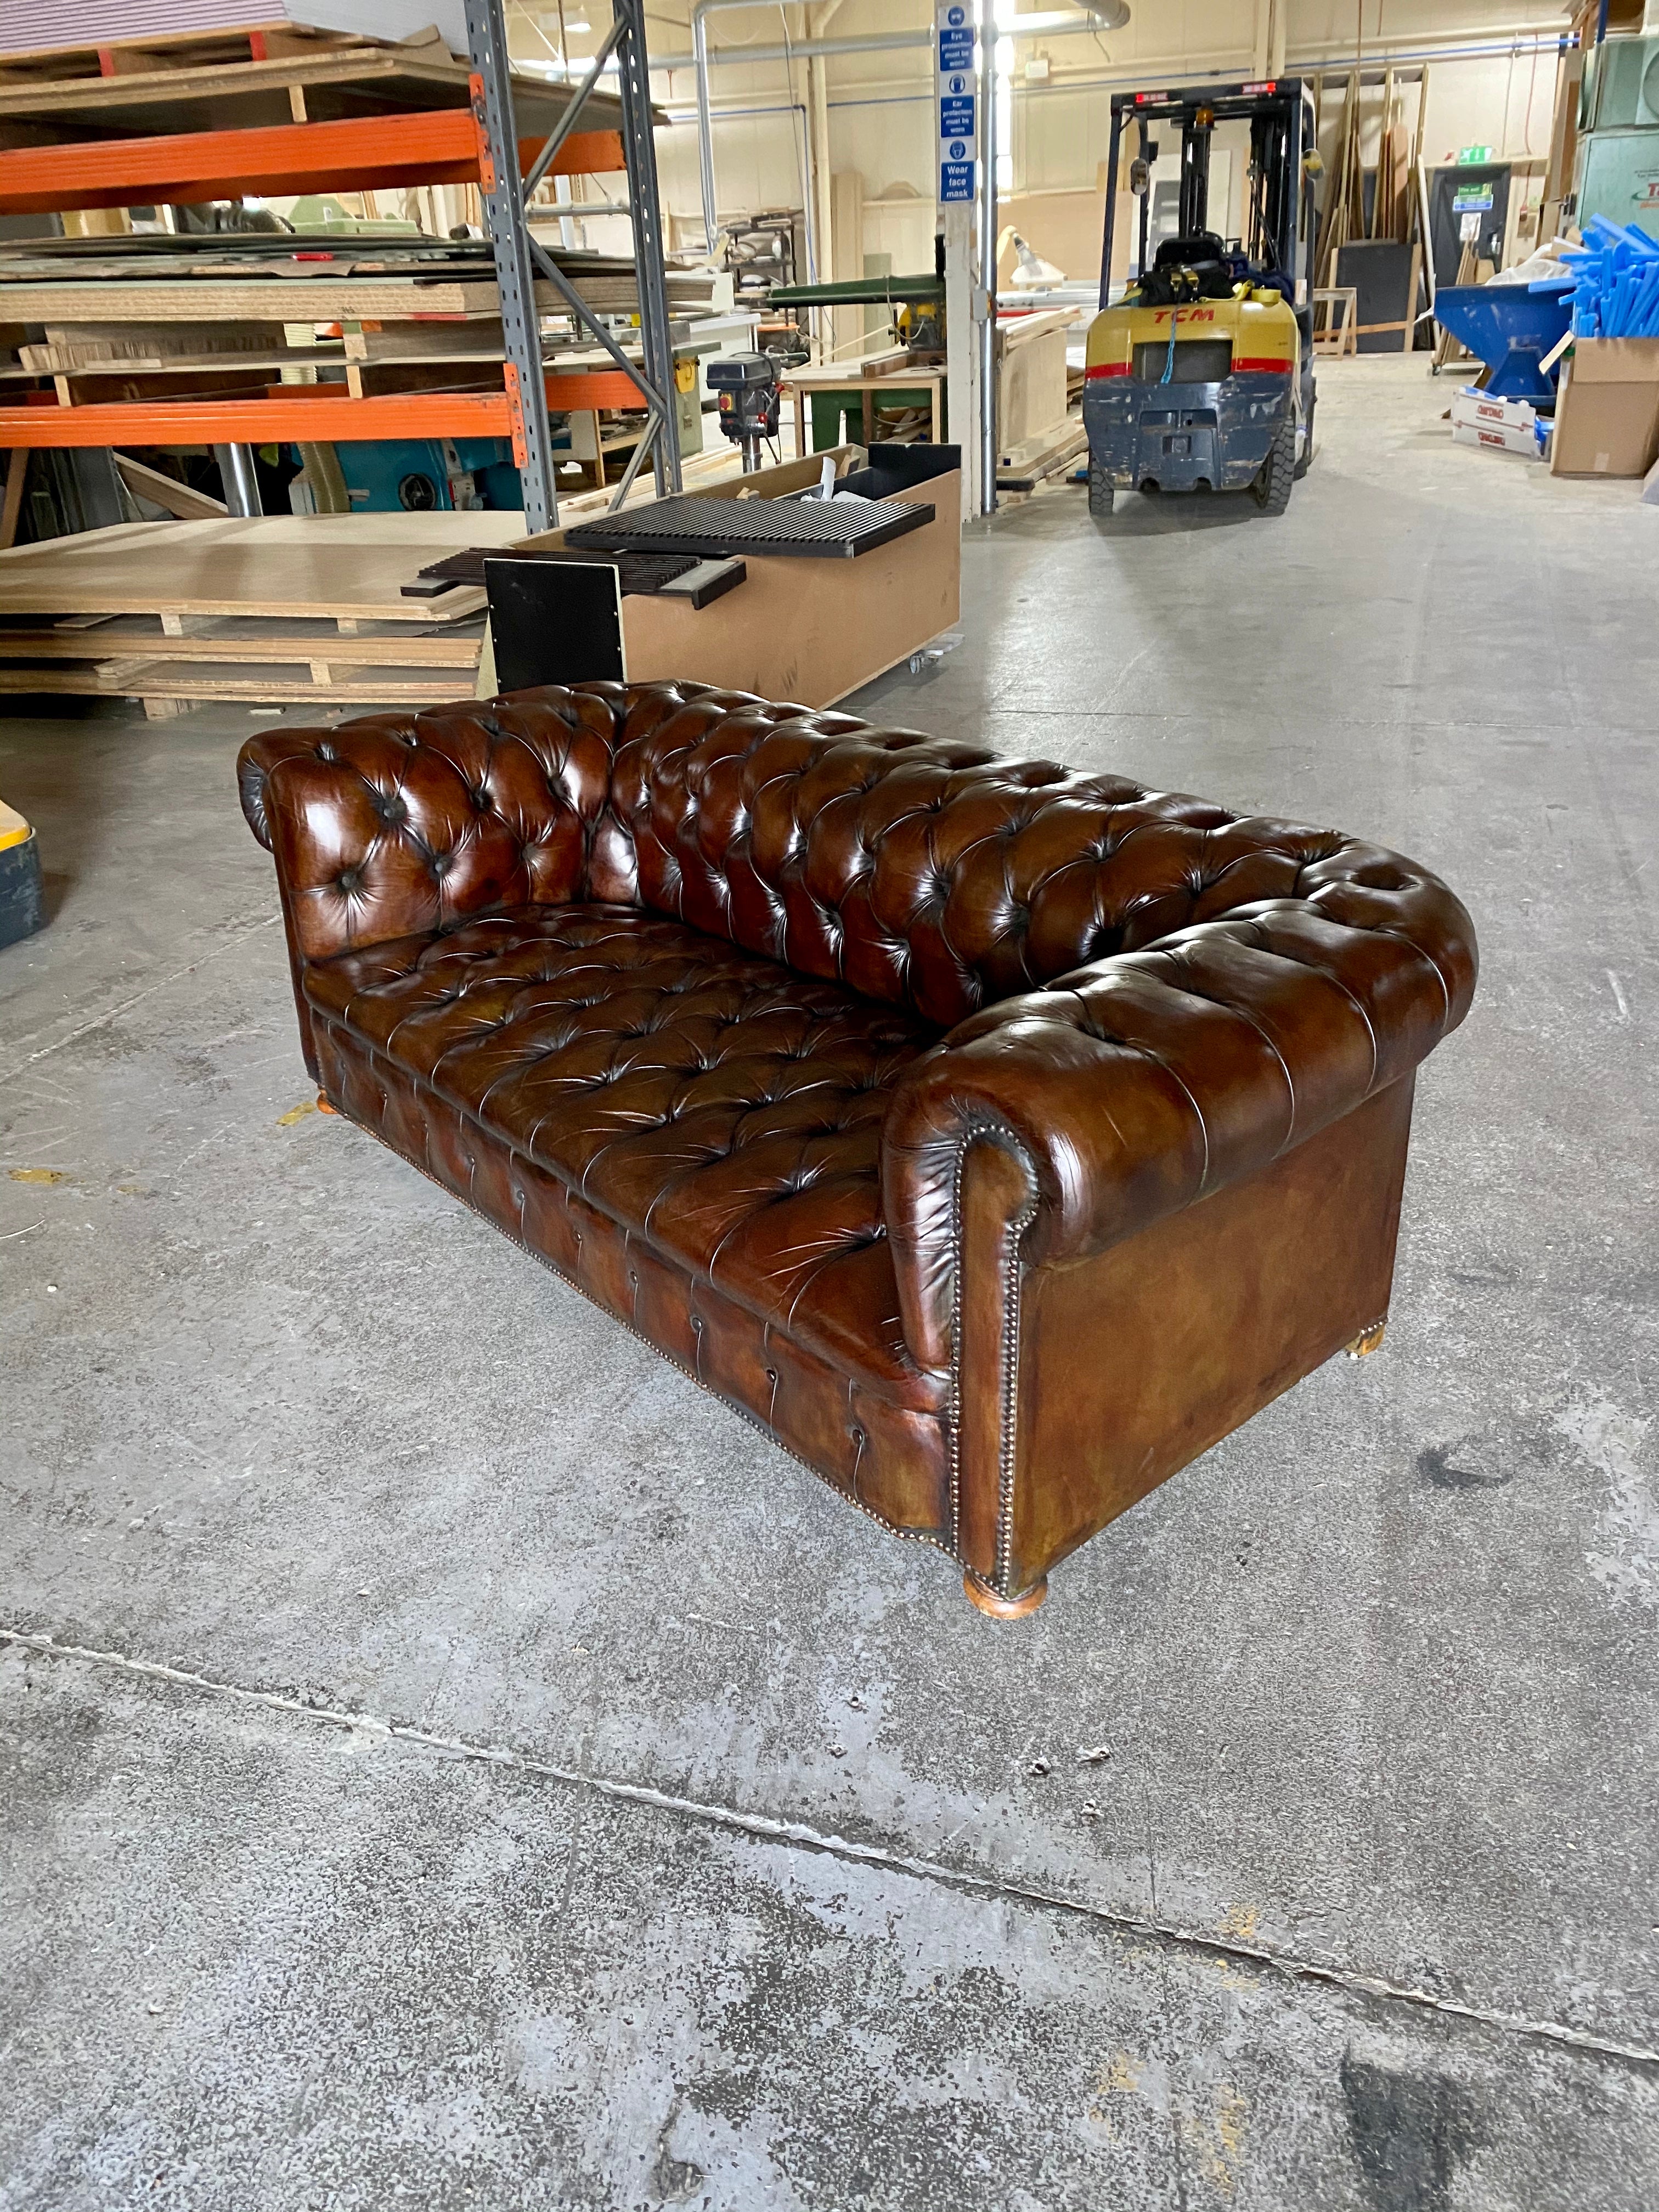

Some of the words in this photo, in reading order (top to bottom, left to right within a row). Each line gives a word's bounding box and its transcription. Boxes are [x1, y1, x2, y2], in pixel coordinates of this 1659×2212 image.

[951, 32, 963, 41] Eye
[941, 42, 973, 52] protection
[943, 109, 973, 118] protection
[947, 165, 968, 174] Wear
[949, 178, 966, 187] face
[946, 189, 968, 198] mask
[1154, 308, 1215, 324] TCM
